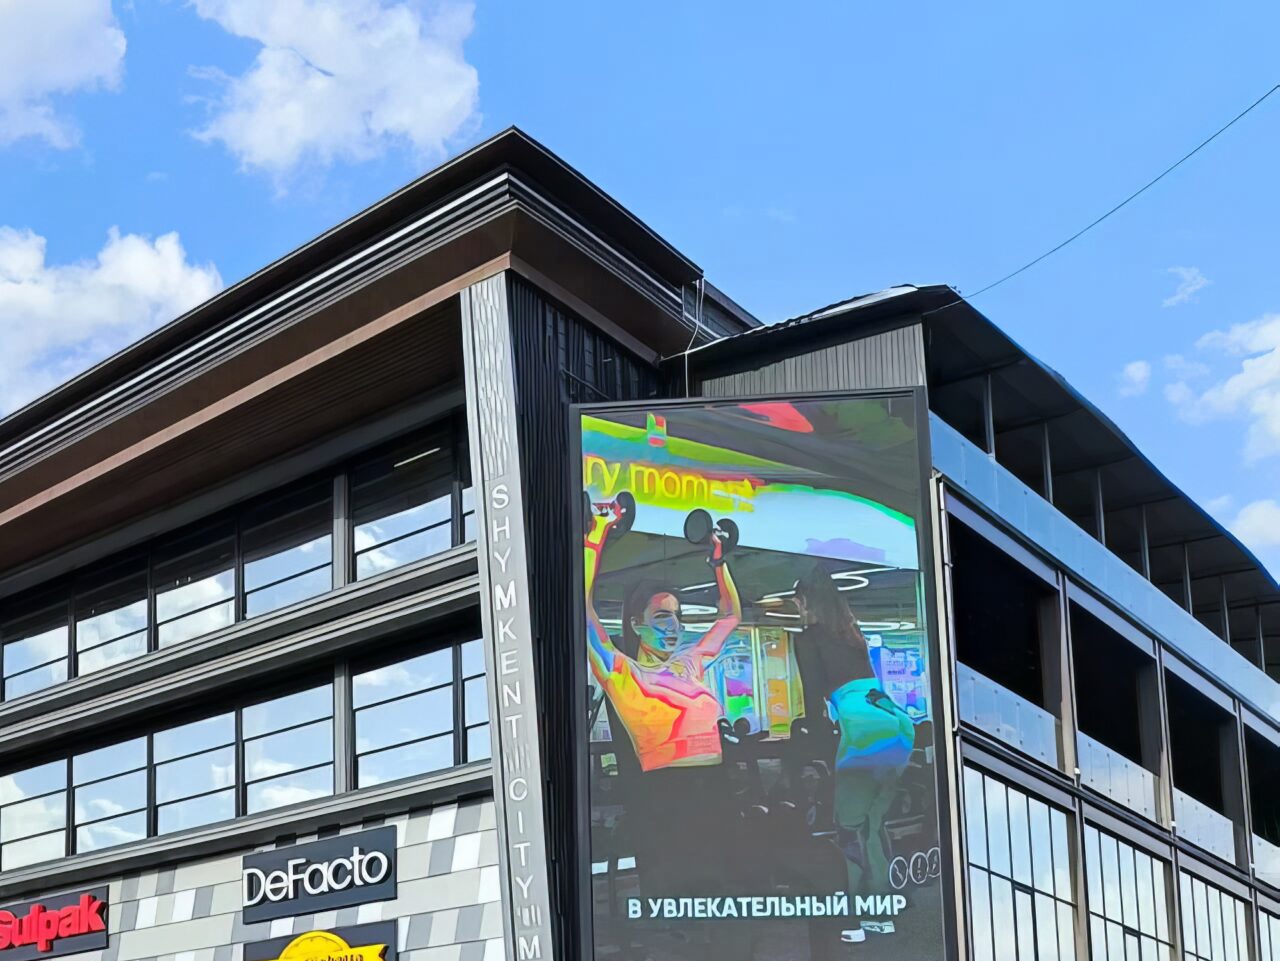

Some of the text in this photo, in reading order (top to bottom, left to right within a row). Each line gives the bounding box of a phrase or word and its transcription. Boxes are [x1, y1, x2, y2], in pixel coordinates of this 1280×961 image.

[492, 484, 522, 738] SHYMKENT
[508, 777, 534, 899] CITY
[242, 846, 388, 907] DeFacto
[627, 891, 908, 919] В УВЛЕКАТЕЛЬНЫЙ МИР
